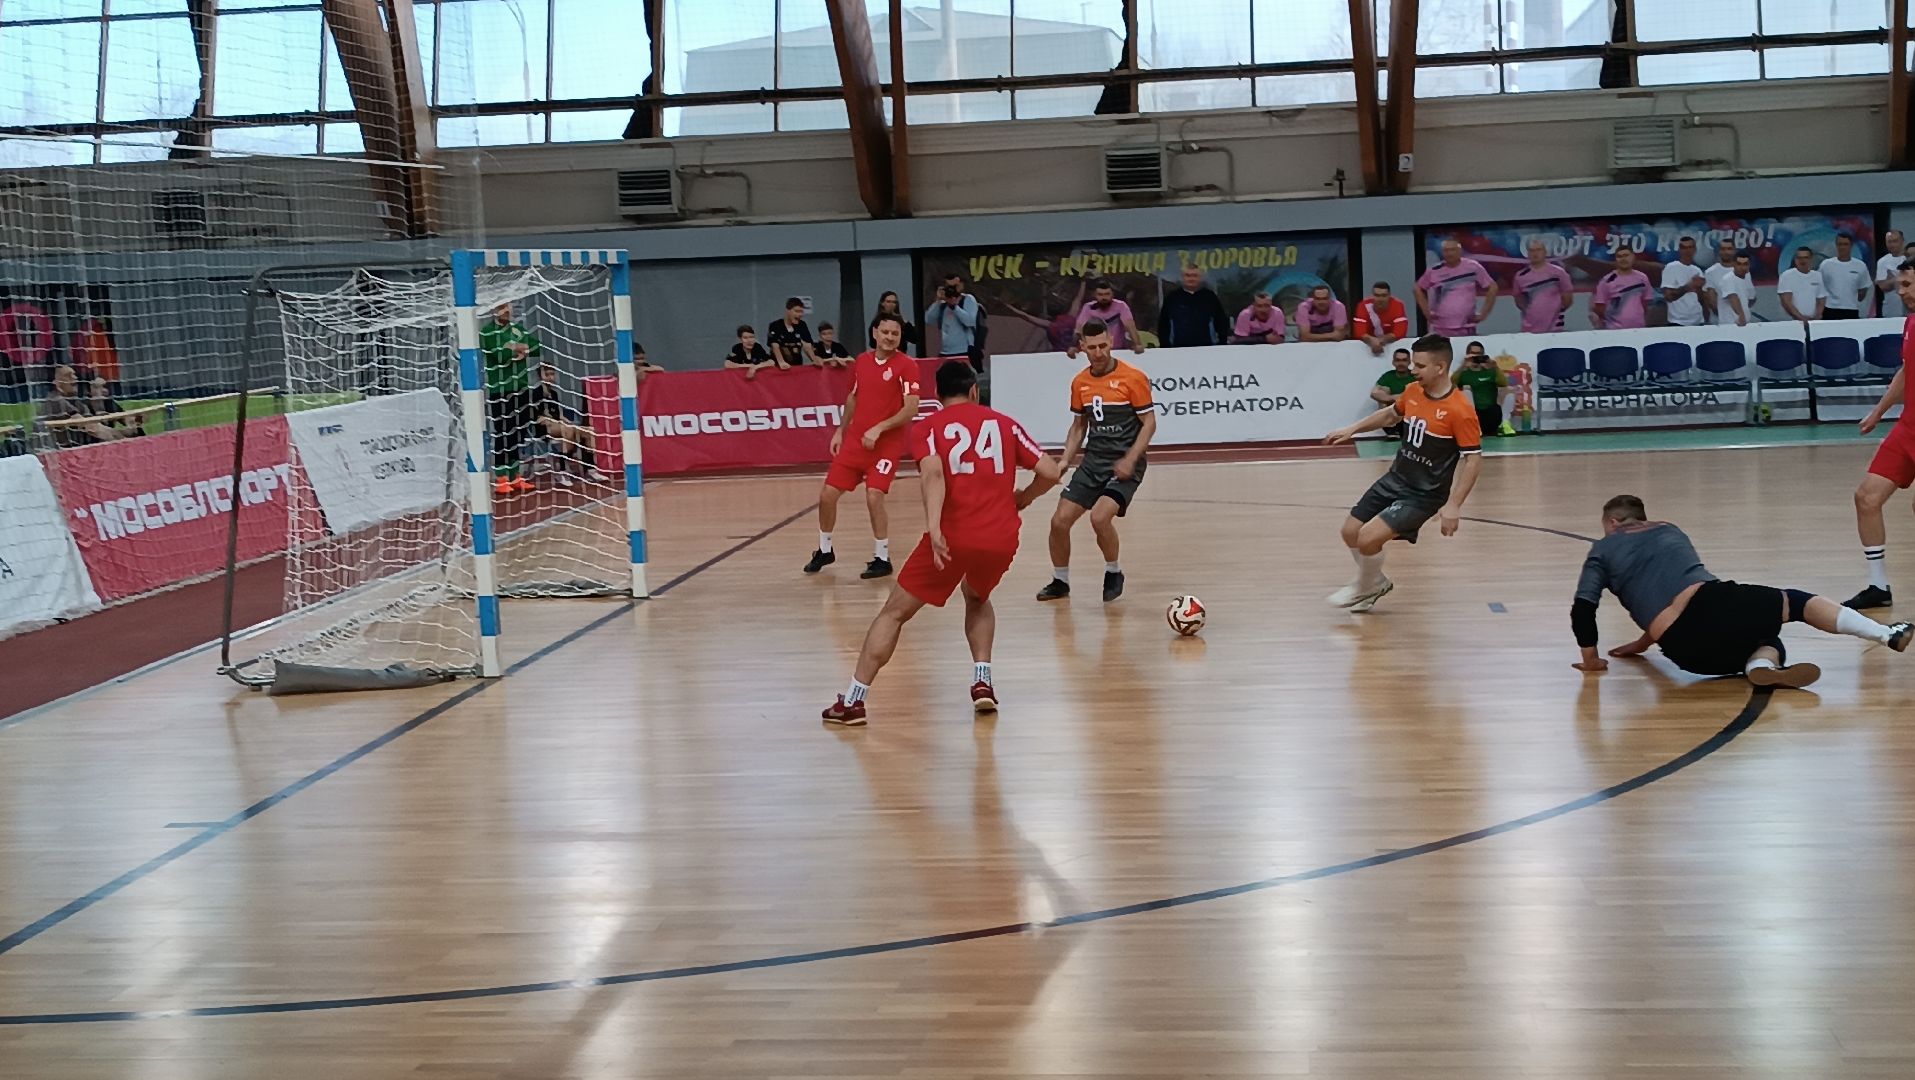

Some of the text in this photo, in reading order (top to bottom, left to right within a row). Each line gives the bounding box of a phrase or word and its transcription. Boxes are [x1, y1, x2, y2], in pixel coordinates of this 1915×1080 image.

[1606, 233, 1646, 255] ЭТО
[969, 254, 1023, 281] УСК
[1060, 252, 1165, 277] КУЗНИЦА
[1178, 246, 1297, 271] ЗДОРОВЬЯ
[1150, 374, 1259, 391] КОМАНДА
[642, 405, 845, 437] МОСОБЛСП
[1093, 395, 1104, 421] 8
[943, 419, 1004, 475] 24
[1405, 416, 1427, 448] 10
